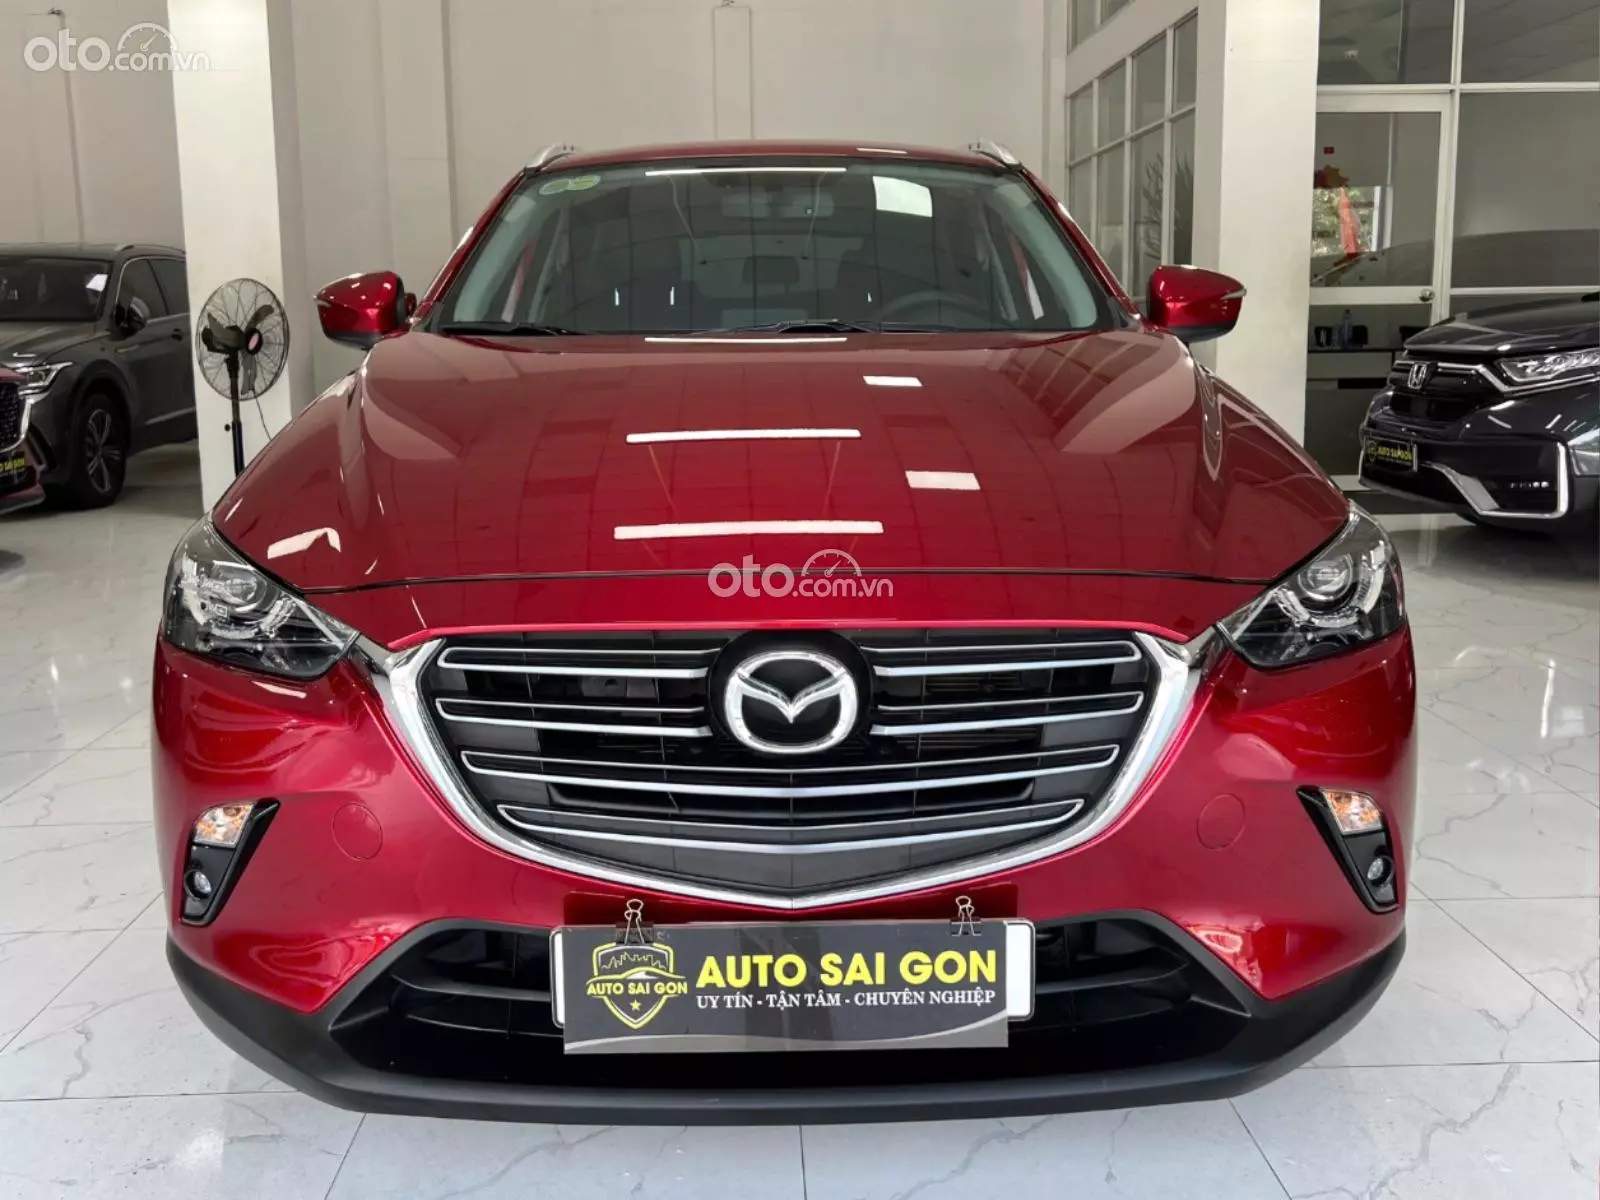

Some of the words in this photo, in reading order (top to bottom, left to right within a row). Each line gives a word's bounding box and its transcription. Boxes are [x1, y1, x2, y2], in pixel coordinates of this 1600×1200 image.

[696, 954, 807, 988] AUTO
[820, 952, 885, 987] SAI
[899, 950, 996, 985] GON
[587, 982, 624, 995] AUTO
[628, 982, 650, 995] SAI
[654, 982, 688, 994] GON
[696, 995, 720, 1009] UY
[724, 991, 754, 1009] TÍN
[766, 990, 800, 1011] TẬN
[804, 989, 841, 1007] TÂM
[854, 987, 925, 1006] CHUYÊN
[929, 986, 996, 1007] NGHIỆP
